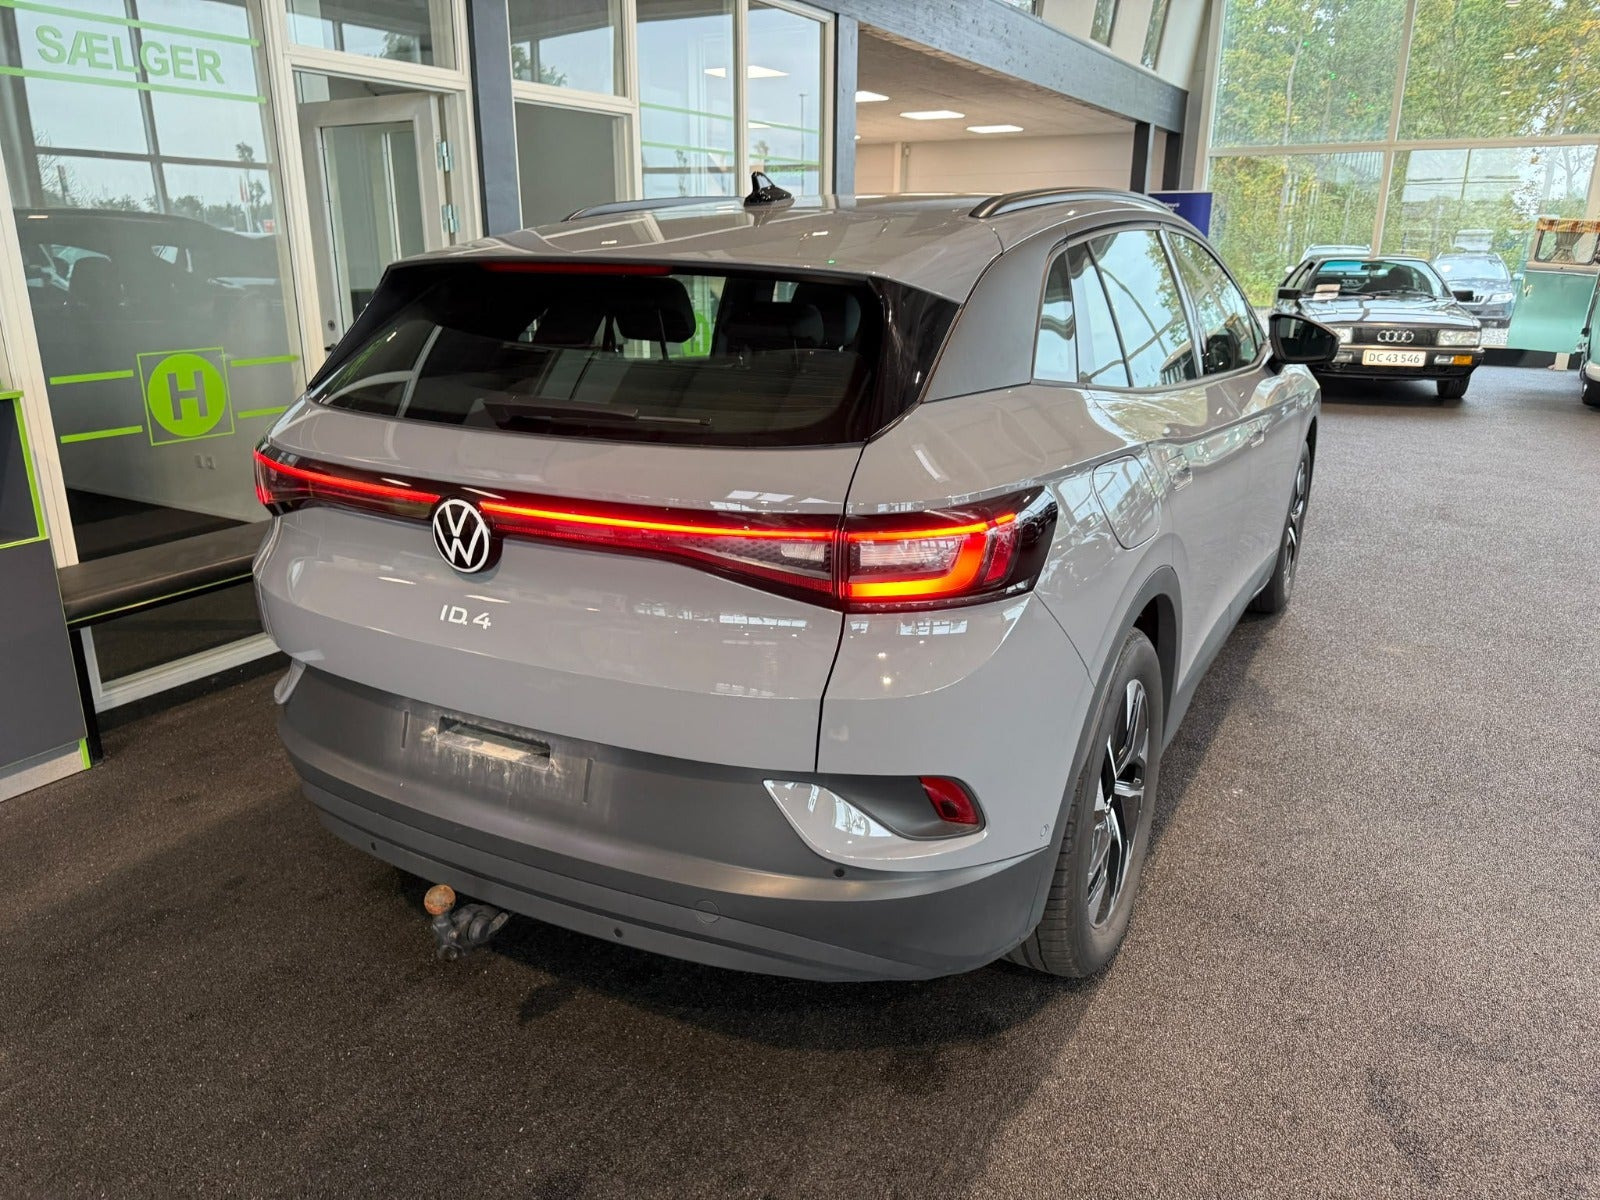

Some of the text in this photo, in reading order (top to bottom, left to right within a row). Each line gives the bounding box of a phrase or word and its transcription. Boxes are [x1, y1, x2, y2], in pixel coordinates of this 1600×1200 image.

[35, 25, 225, 84] SÆLGER
[1368, 352, 1421, 364] DC 43 546
[166, 369, 209, 421] H
[432, 499, 490, 573] VW
